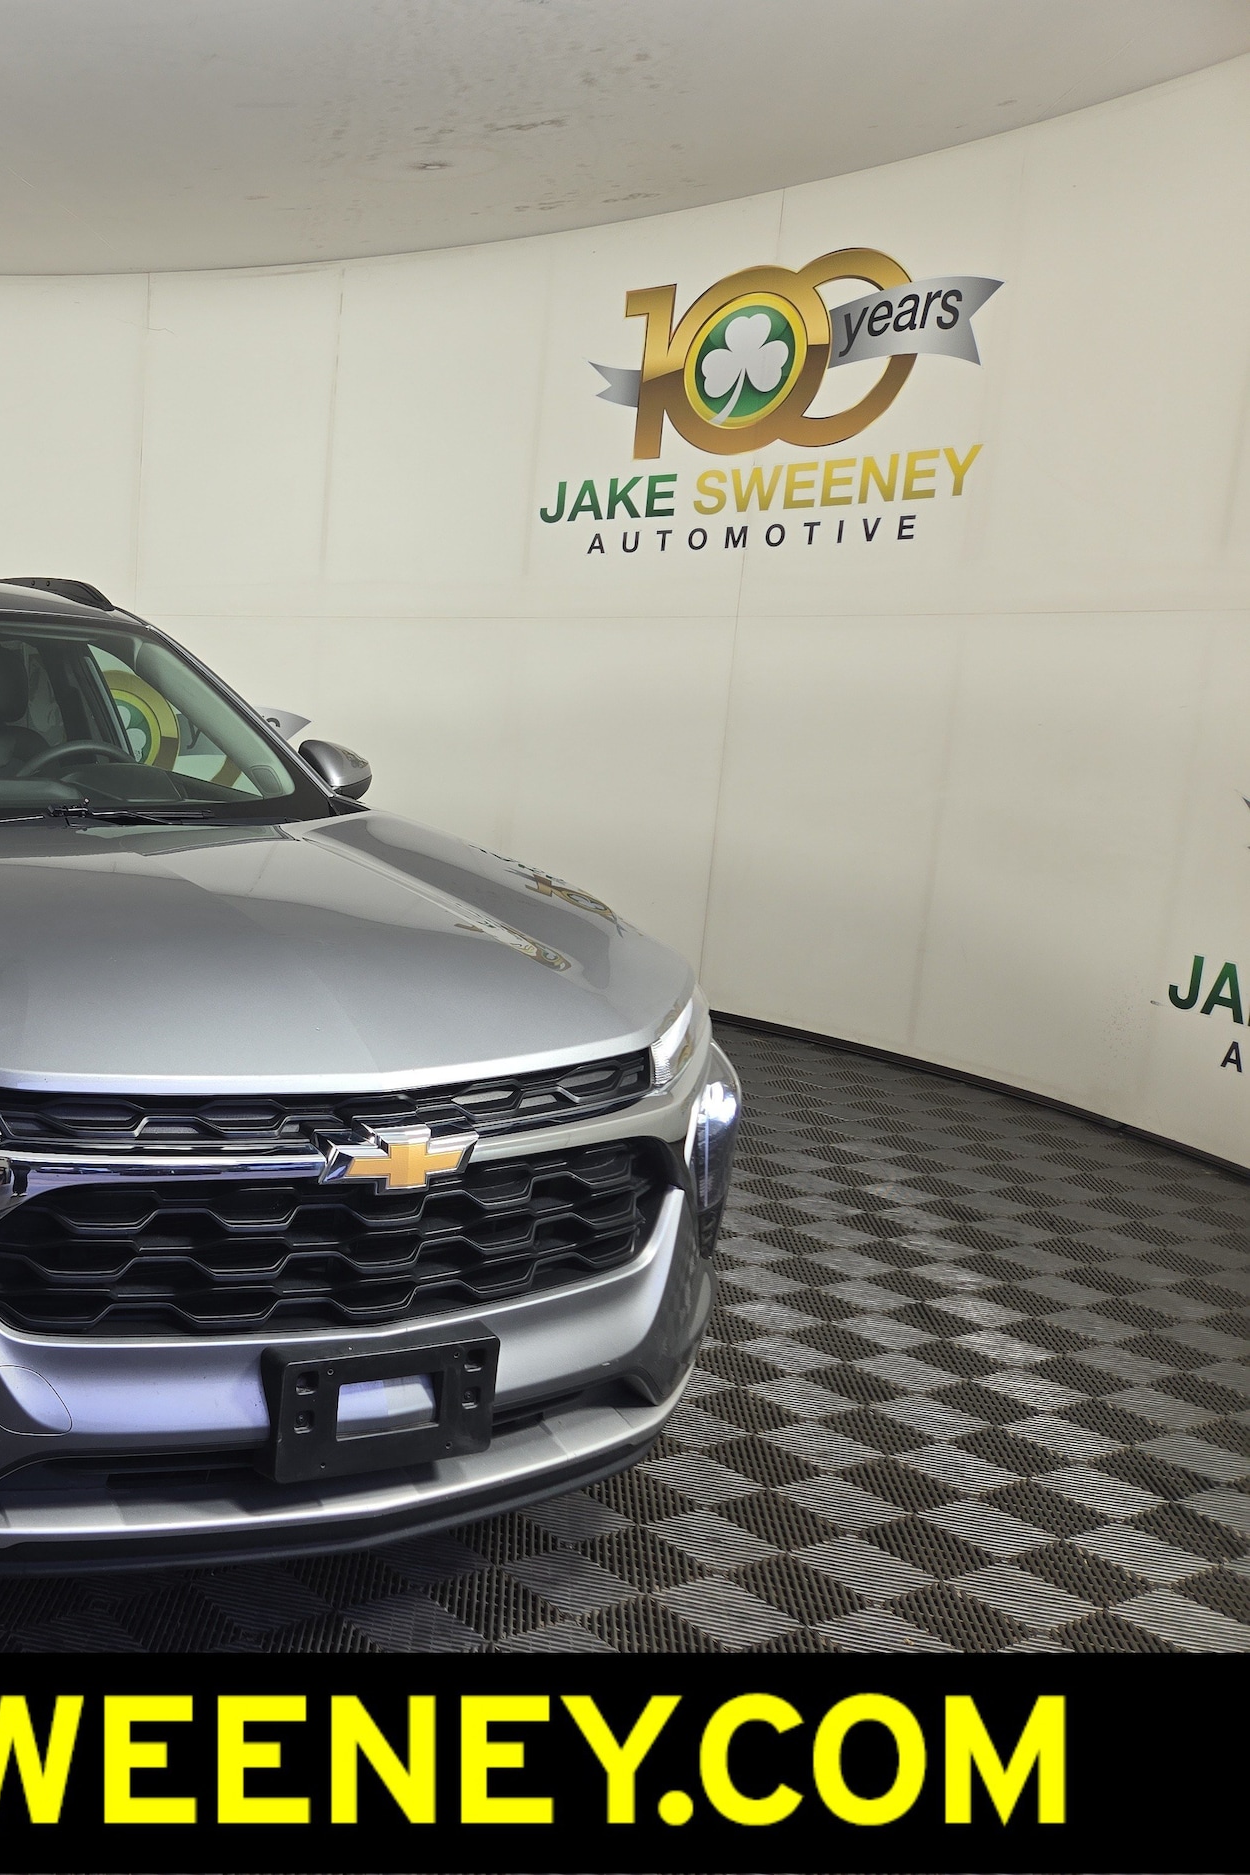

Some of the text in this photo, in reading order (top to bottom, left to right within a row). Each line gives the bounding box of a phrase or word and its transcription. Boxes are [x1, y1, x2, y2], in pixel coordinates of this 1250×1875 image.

[625, 247, 963, 460] 100 years
[540, 444, 985, 524] JAKE SWEENEY
[587, 514, 917, 555] AUTOMOTIVE
[1168, 954, 1250, 1027] JA
